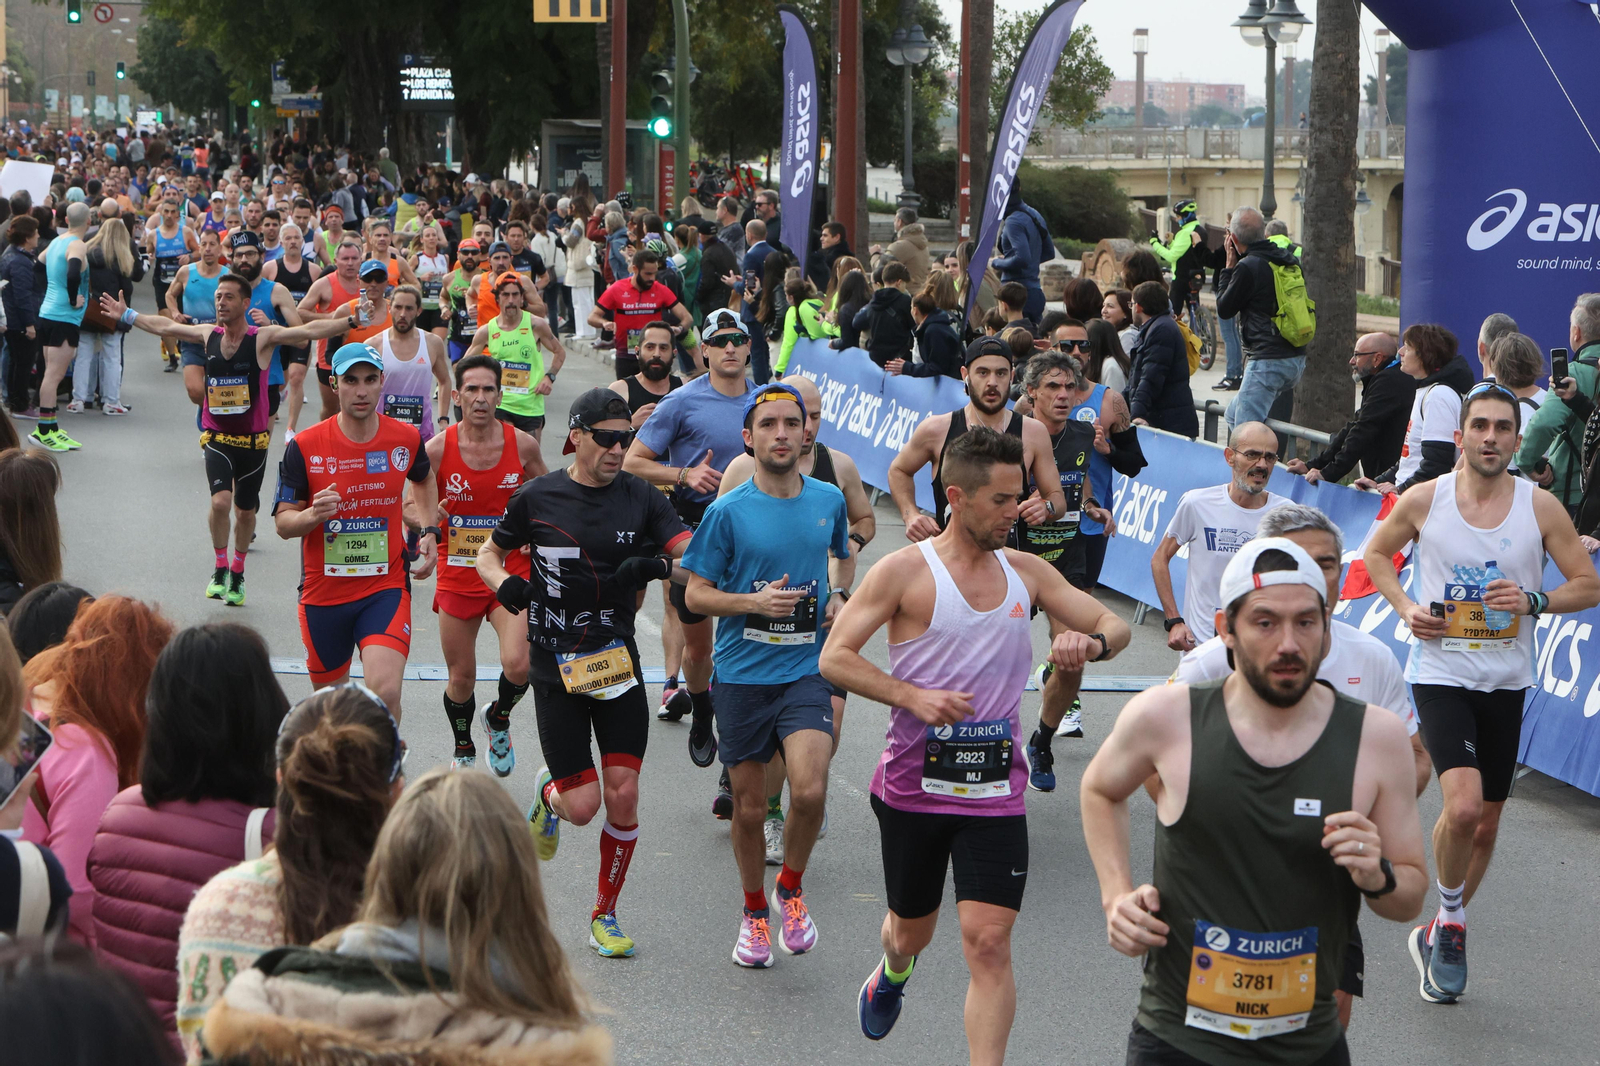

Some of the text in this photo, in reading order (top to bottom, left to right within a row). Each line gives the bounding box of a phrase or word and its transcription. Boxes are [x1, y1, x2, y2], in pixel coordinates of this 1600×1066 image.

[411, 67, 434, 78] PLAZA
[411, 78, 425, 89] LOS
[410, 89, 443, 100] AVENIDA
[1002, 80, 1036, 177] asics
[664, 165, 674, 197] PASEO
[1526, 203, 1600, 242] asi
[1517, 256, 1560, 270] sound
[1560, 256, 1594, 271] mind,
[502, 339, 519, 347] Luis
[847, 391, 883, 439] asics
[1060, 474, 1077, 482] RICH
[346, 482, 385, 494] ATLETISMO
[445, 491, 473, 501] Sevilla
[1118, 481, 1168, 544] asics
[346, 521, 381, 530] ZURICH
[466, 518, 498, 526] ZURICH
[466, 535, 485, 543] 4368
[345, 540, 367, 550] 1294
[344, 554, 370, 563] GÓMEZ
[769, 622, 796, 632] LUCAS
[1463, 628, 1500, 637] ??D??A?
[586, 659, 610, 674] 4083
[571, 671, 632, 693] DOUDOU D'AMOR
[958, 724, 1004, 737] ZURICH
[955, 751, 985, 763] 2923
[966, 772, 982, 782] MJ
[1236, 936, 1303, 955] ZURICH
[1232, 972, 1274, 990] 3781
[1235, 1001, 1270, 1016] NICK
